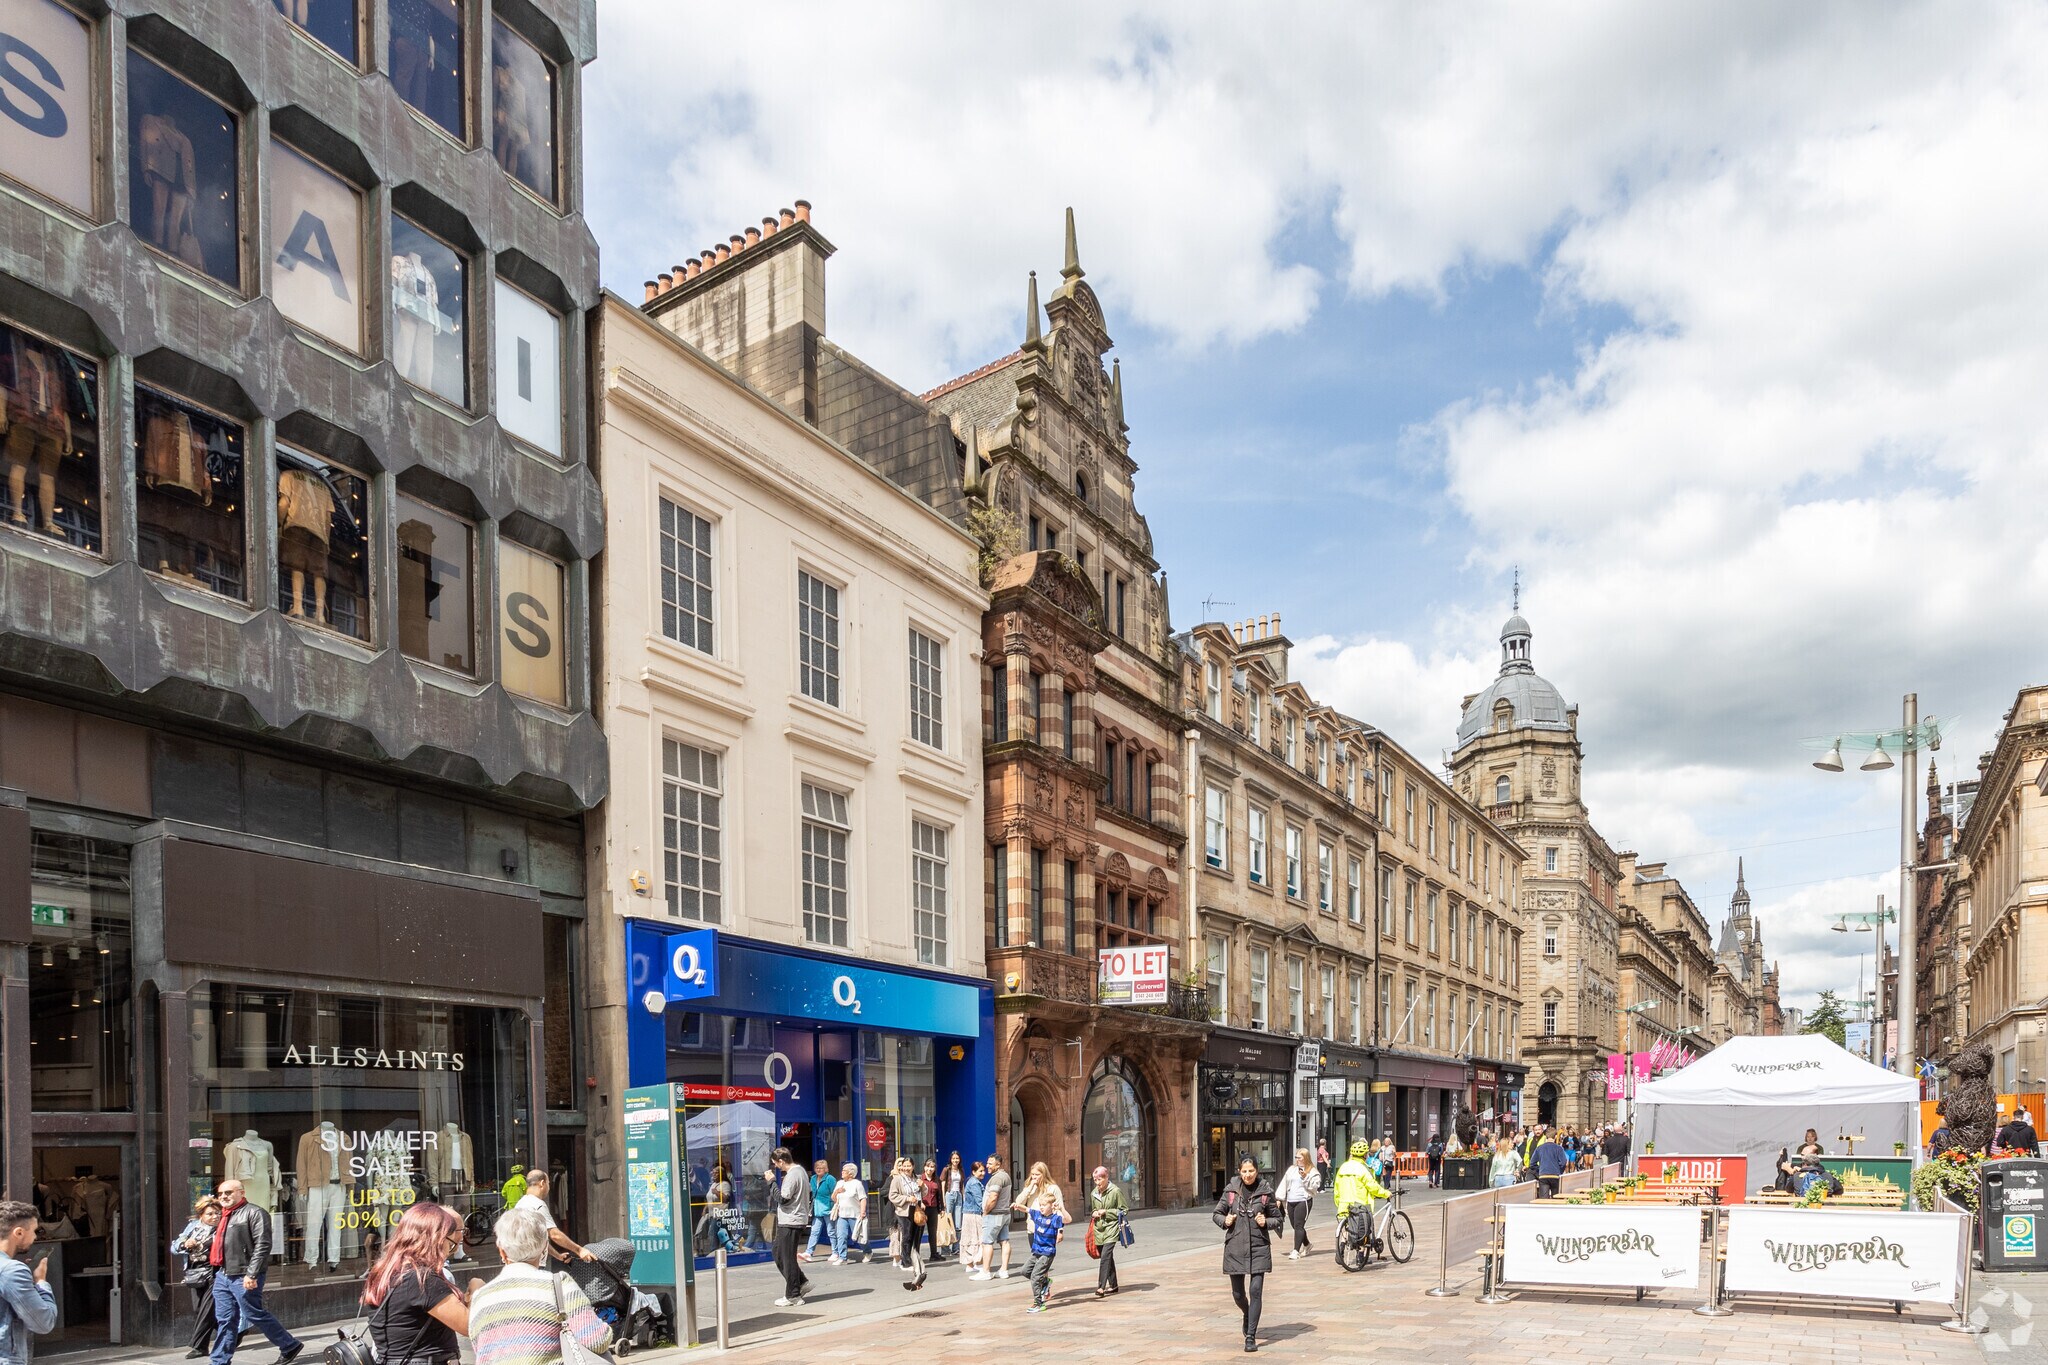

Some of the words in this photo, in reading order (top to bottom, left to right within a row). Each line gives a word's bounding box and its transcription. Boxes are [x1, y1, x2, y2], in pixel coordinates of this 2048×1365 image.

[0, 32, 68, 138] S
[276, 210, 352, 304] A
[517, 336, 531, 402] I
[506, 592, 551, 659] S
[1100, 953, 1126, 977] TO
[1132, 951, 1166, 975] LET
[832, 975, 862, 1014] O2
[1136, 982, 1164, 990] Culverwell
[282, 1044, 465, 1071] ALLSAINTS
[1731, 1060, 1824, 1075] WUNDERBAR
[763, 1052, 800, 1100] O2
[320, 1130, 438, 1152] SUMMER
[349, 1156, 415, 1178] SALE
[349, 1189, 381, 1207] UP
[386, 1188, 416, 1206] TO
[334, 1211, 381, 1230] 50%
[712, 1207, 738, 1218] Roam
[722, 1217, 739, 1225] freely
[727, 1223, 737, 1231] the
[737, 1222, 745, 1230] EU
[1536, 1228, 1660, 1264] WUNDERBAR
[1764, 1236, 1910, 1272] WUNDERBAR
[2006, 1244, 2033, 1252] Glasgow
